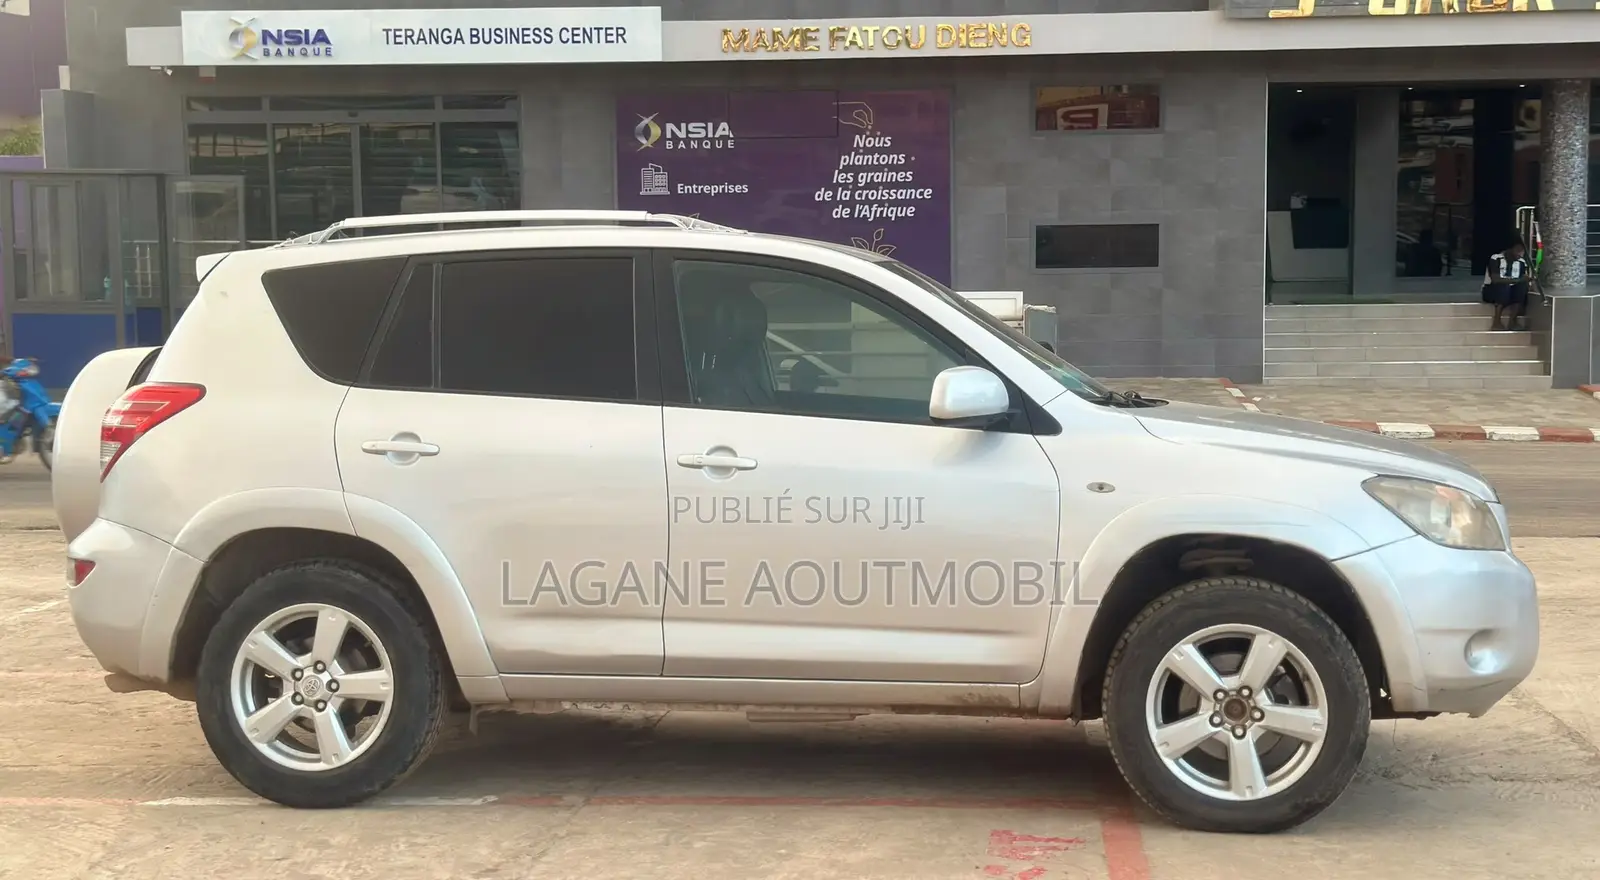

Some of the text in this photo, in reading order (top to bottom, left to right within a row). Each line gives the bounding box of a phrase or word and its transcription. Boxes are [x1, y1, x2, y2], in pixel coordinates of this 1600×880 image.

[261, 28, 332, 46] NSIA
[382, 26, 627, 45] TERANGA BUSINESS CENTER
[721, 22, 1031, 52] MAME FATOU DIENG
[263, 47, 332, 57] BANQUE
[666, 122, 734, 139] NSIA
[666, 140, 734, 149] BANQUE
[853, 134, 892, 148] Nous
[839, 151, 906, 169] plantons
[833, 168, 913, 187] les graines
[677, 182, 749, 196] Entreprises
[815, 186, 933, 201] de la croissance
[832, 203, 916, 221] de l'Afrique
